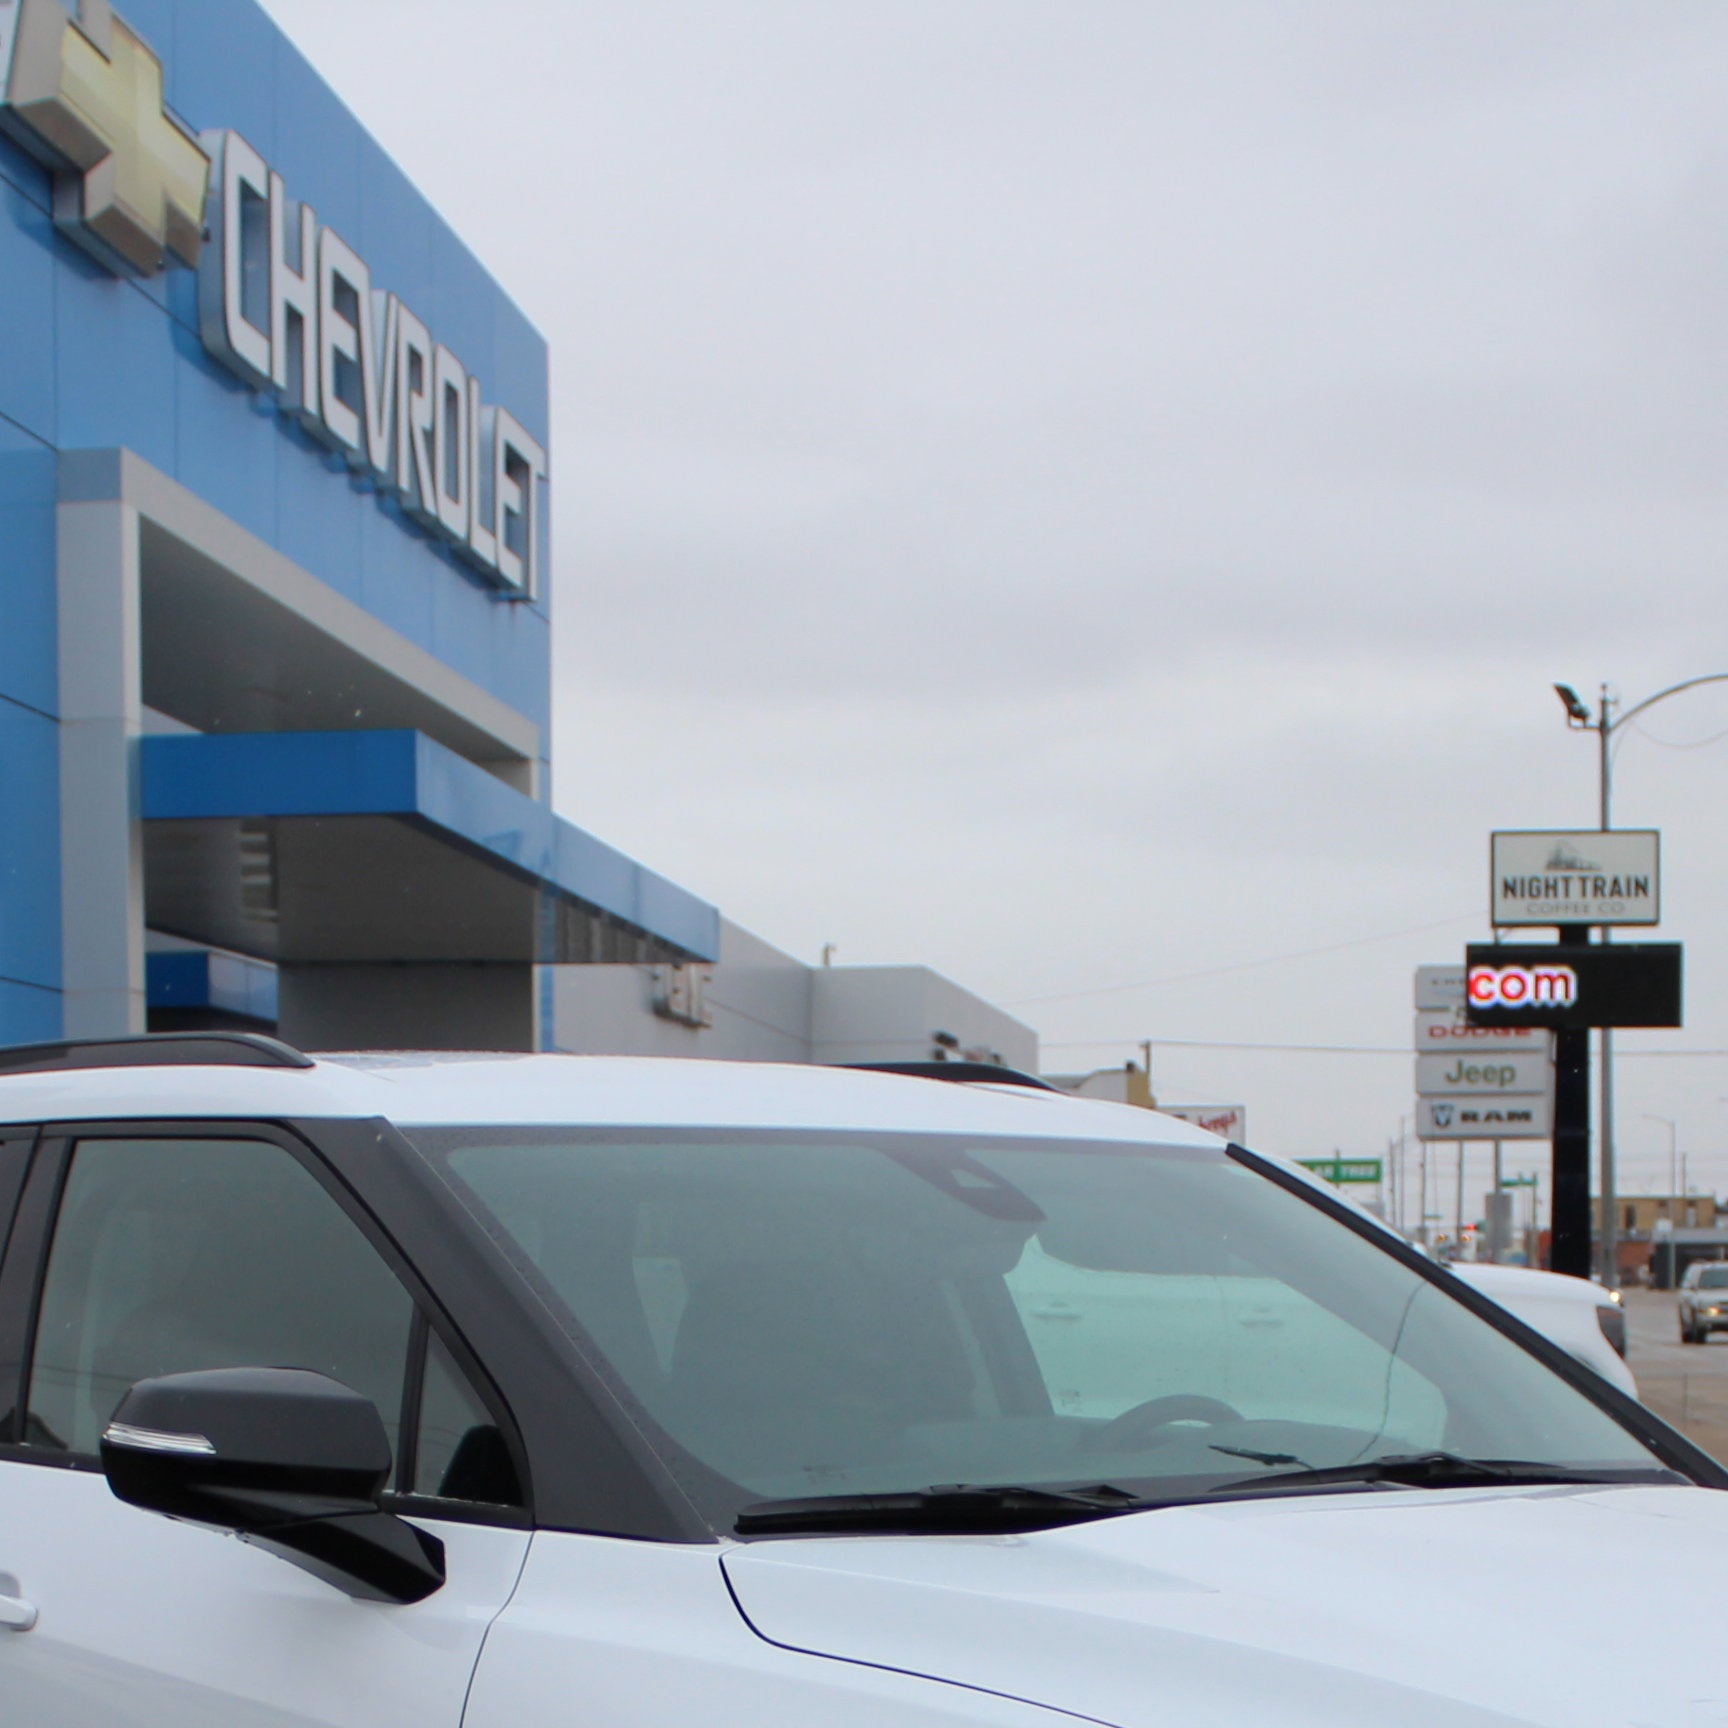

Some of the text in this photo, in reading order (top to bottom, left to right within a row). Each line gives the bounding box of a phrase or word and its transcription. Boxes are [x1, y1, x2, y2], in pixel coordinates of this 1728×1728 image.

[198, 128, 546, 602] CHEVROLET
[1502, 875, 1650, 899] NIGHT TRAIN
[1526, 900, 1626, 915] COFFEE CO
[1445, 1059, 1517, 1087] Jeep
[1459, 1109, 1533, 1123] RAM
